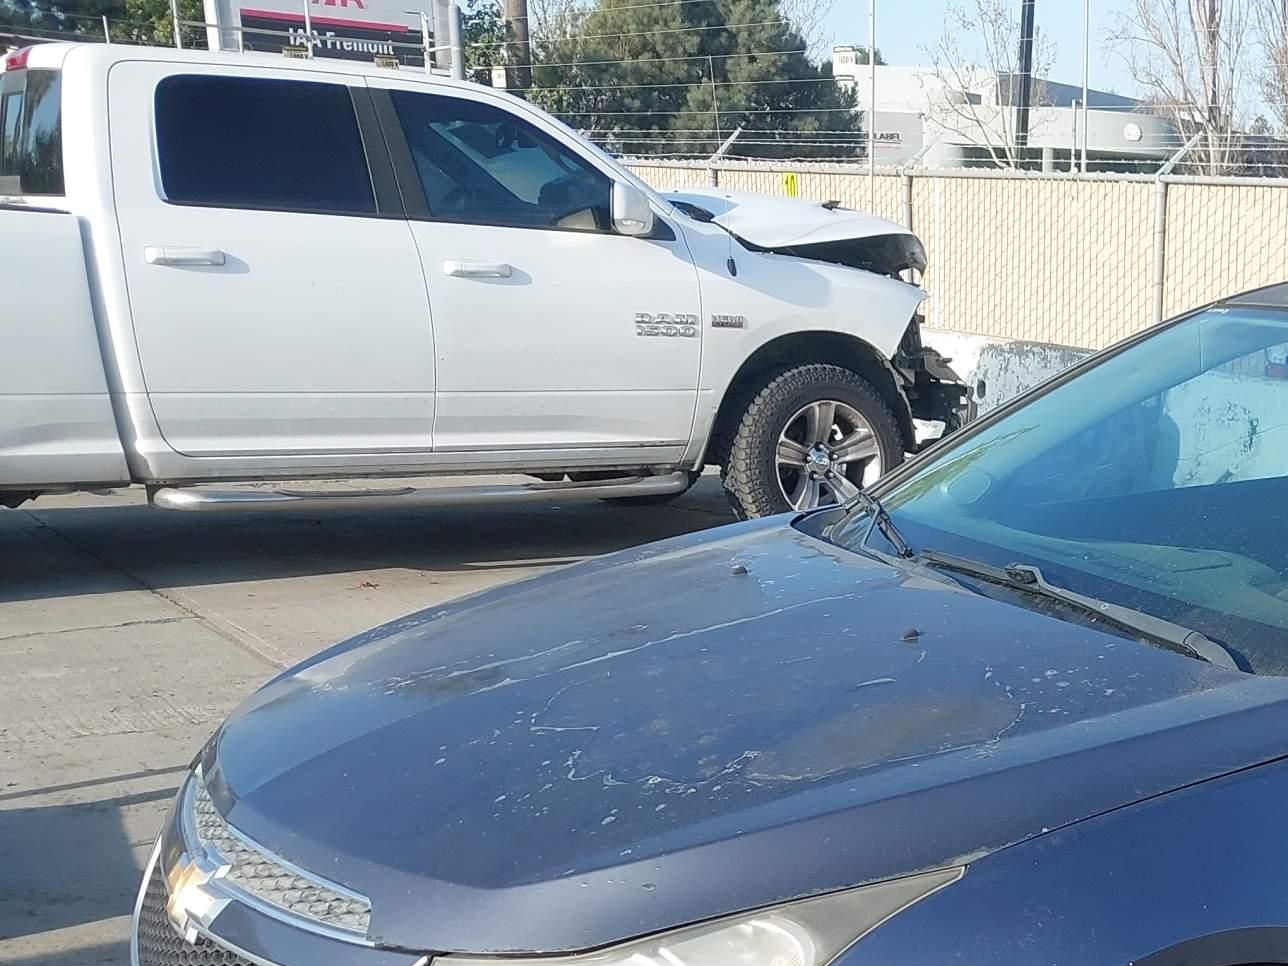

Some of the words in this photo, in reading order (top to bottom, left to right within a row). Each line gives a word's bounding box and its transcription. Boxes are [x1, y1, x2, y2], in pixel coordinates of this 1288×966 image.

[288, 27, 323, 49] IAA
[326, 31, 395, 55] Fremont
[634, 312, 698, 325] RAM
[635, 325, 698, 338] 1500
